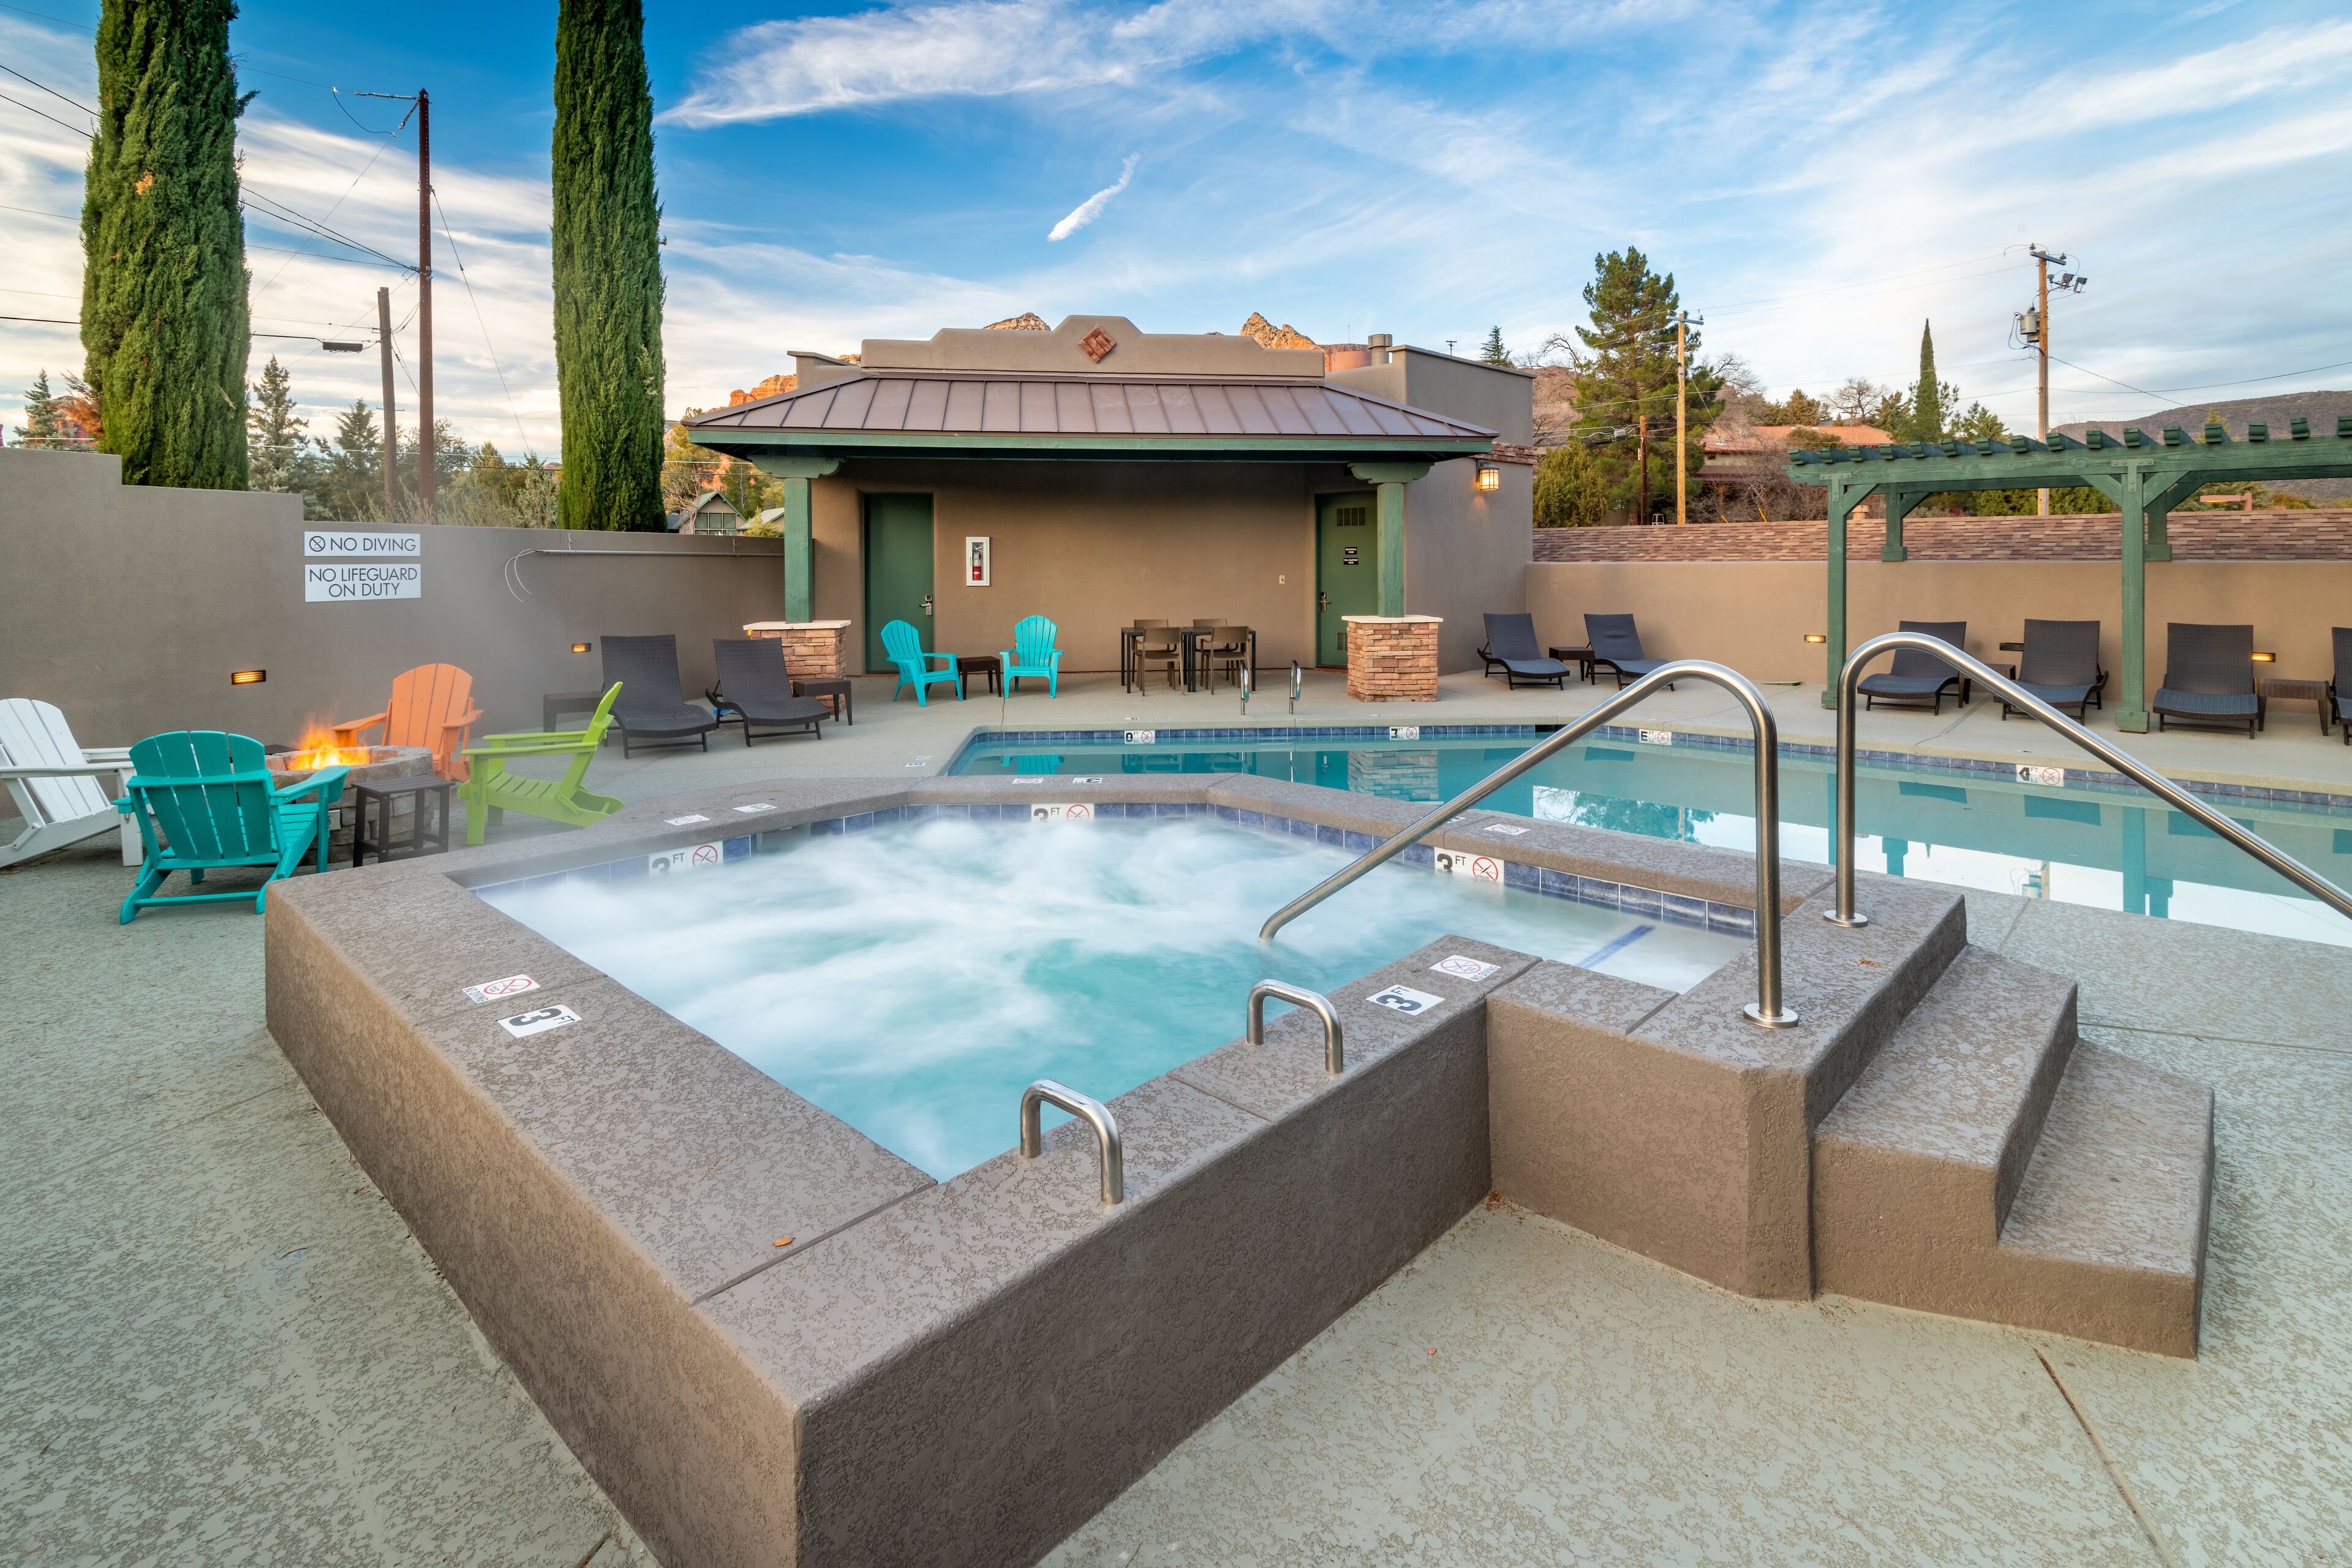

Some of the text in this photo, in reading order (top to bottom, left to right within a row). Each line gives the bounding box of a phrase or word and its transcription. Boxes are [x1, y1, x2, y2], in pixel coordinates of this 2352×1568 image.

[331, 537, 416, 551] NO DIVING
[310, 568, 417, 582] NO LIFEGUARD
[329, 582, 400, 597] ON DUTY
[673, 853, 685, 864] FT
[1455, 855, 1466, 866] FT
[1477, 965, 1499, 977] DIVING
[1376, 986, 1422, 1011] 3 FT
[509, 1008, 576, 1027] 3 FT
